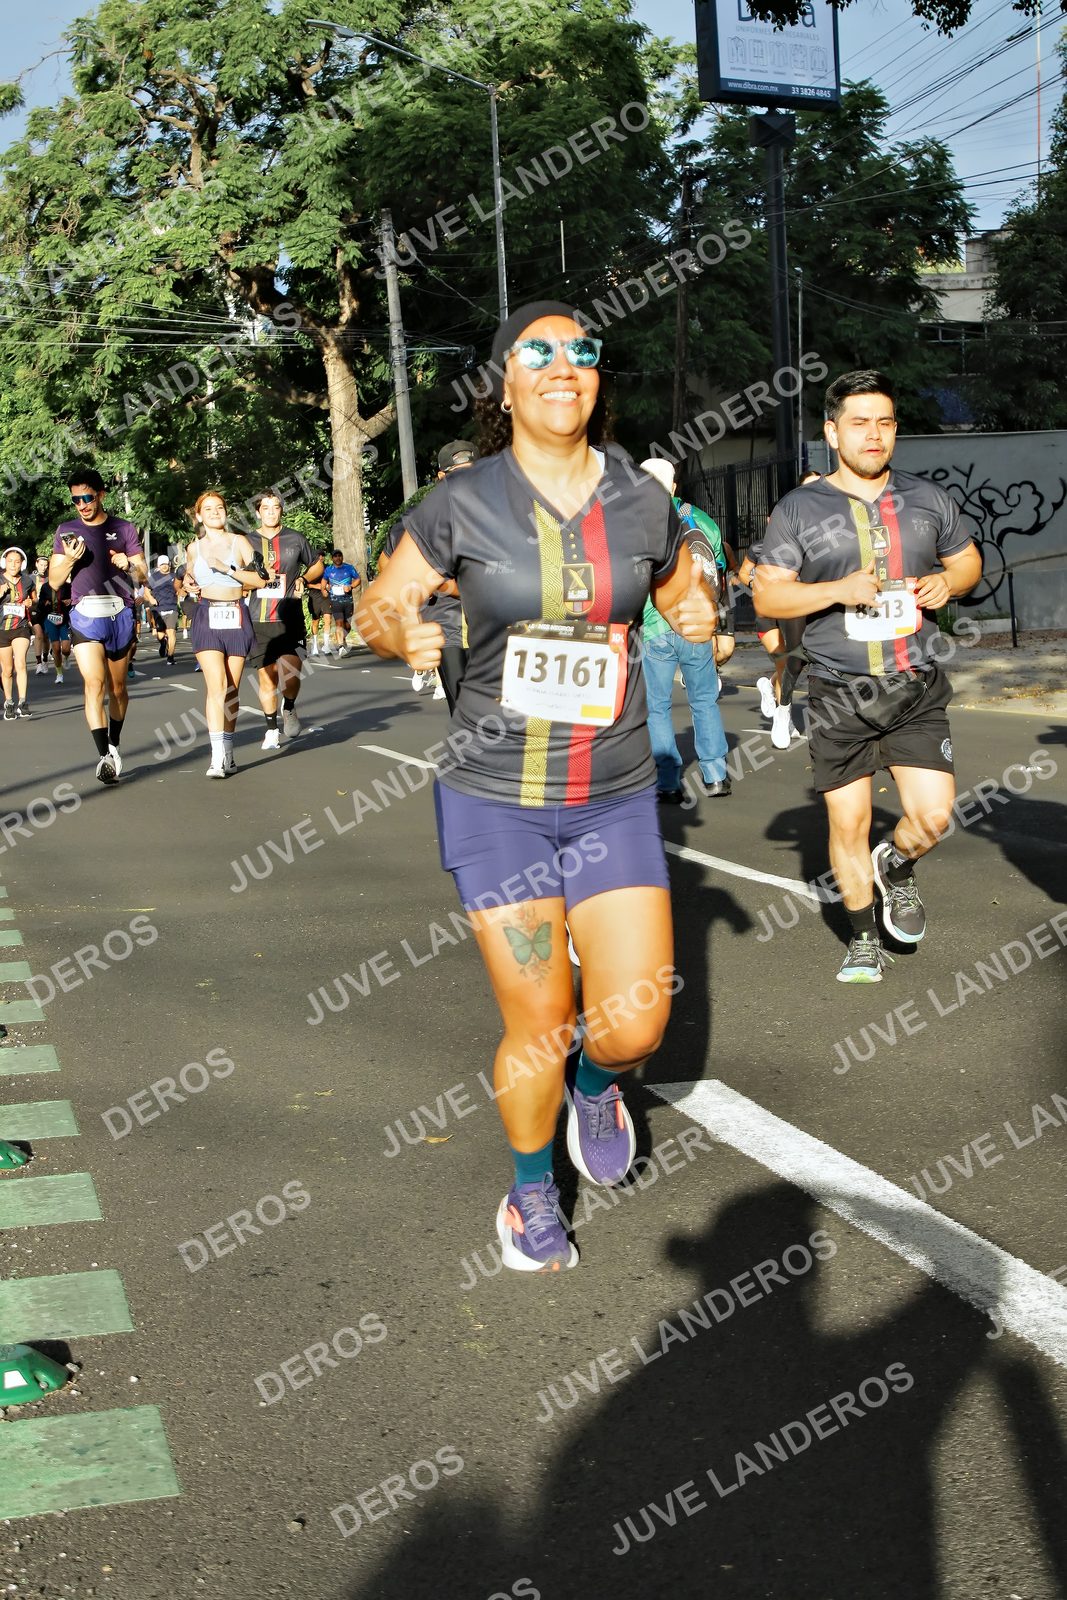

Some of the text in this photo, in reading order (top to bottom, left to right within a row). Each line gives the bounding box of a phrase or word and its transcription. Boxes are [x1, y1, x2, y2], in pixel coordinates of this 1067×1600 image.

[728, 81, 779, 92] www.dibra.com.mx
[791, 86, 831, 98] 33 3826 4845
[514, 649, 608, 689] 13161
